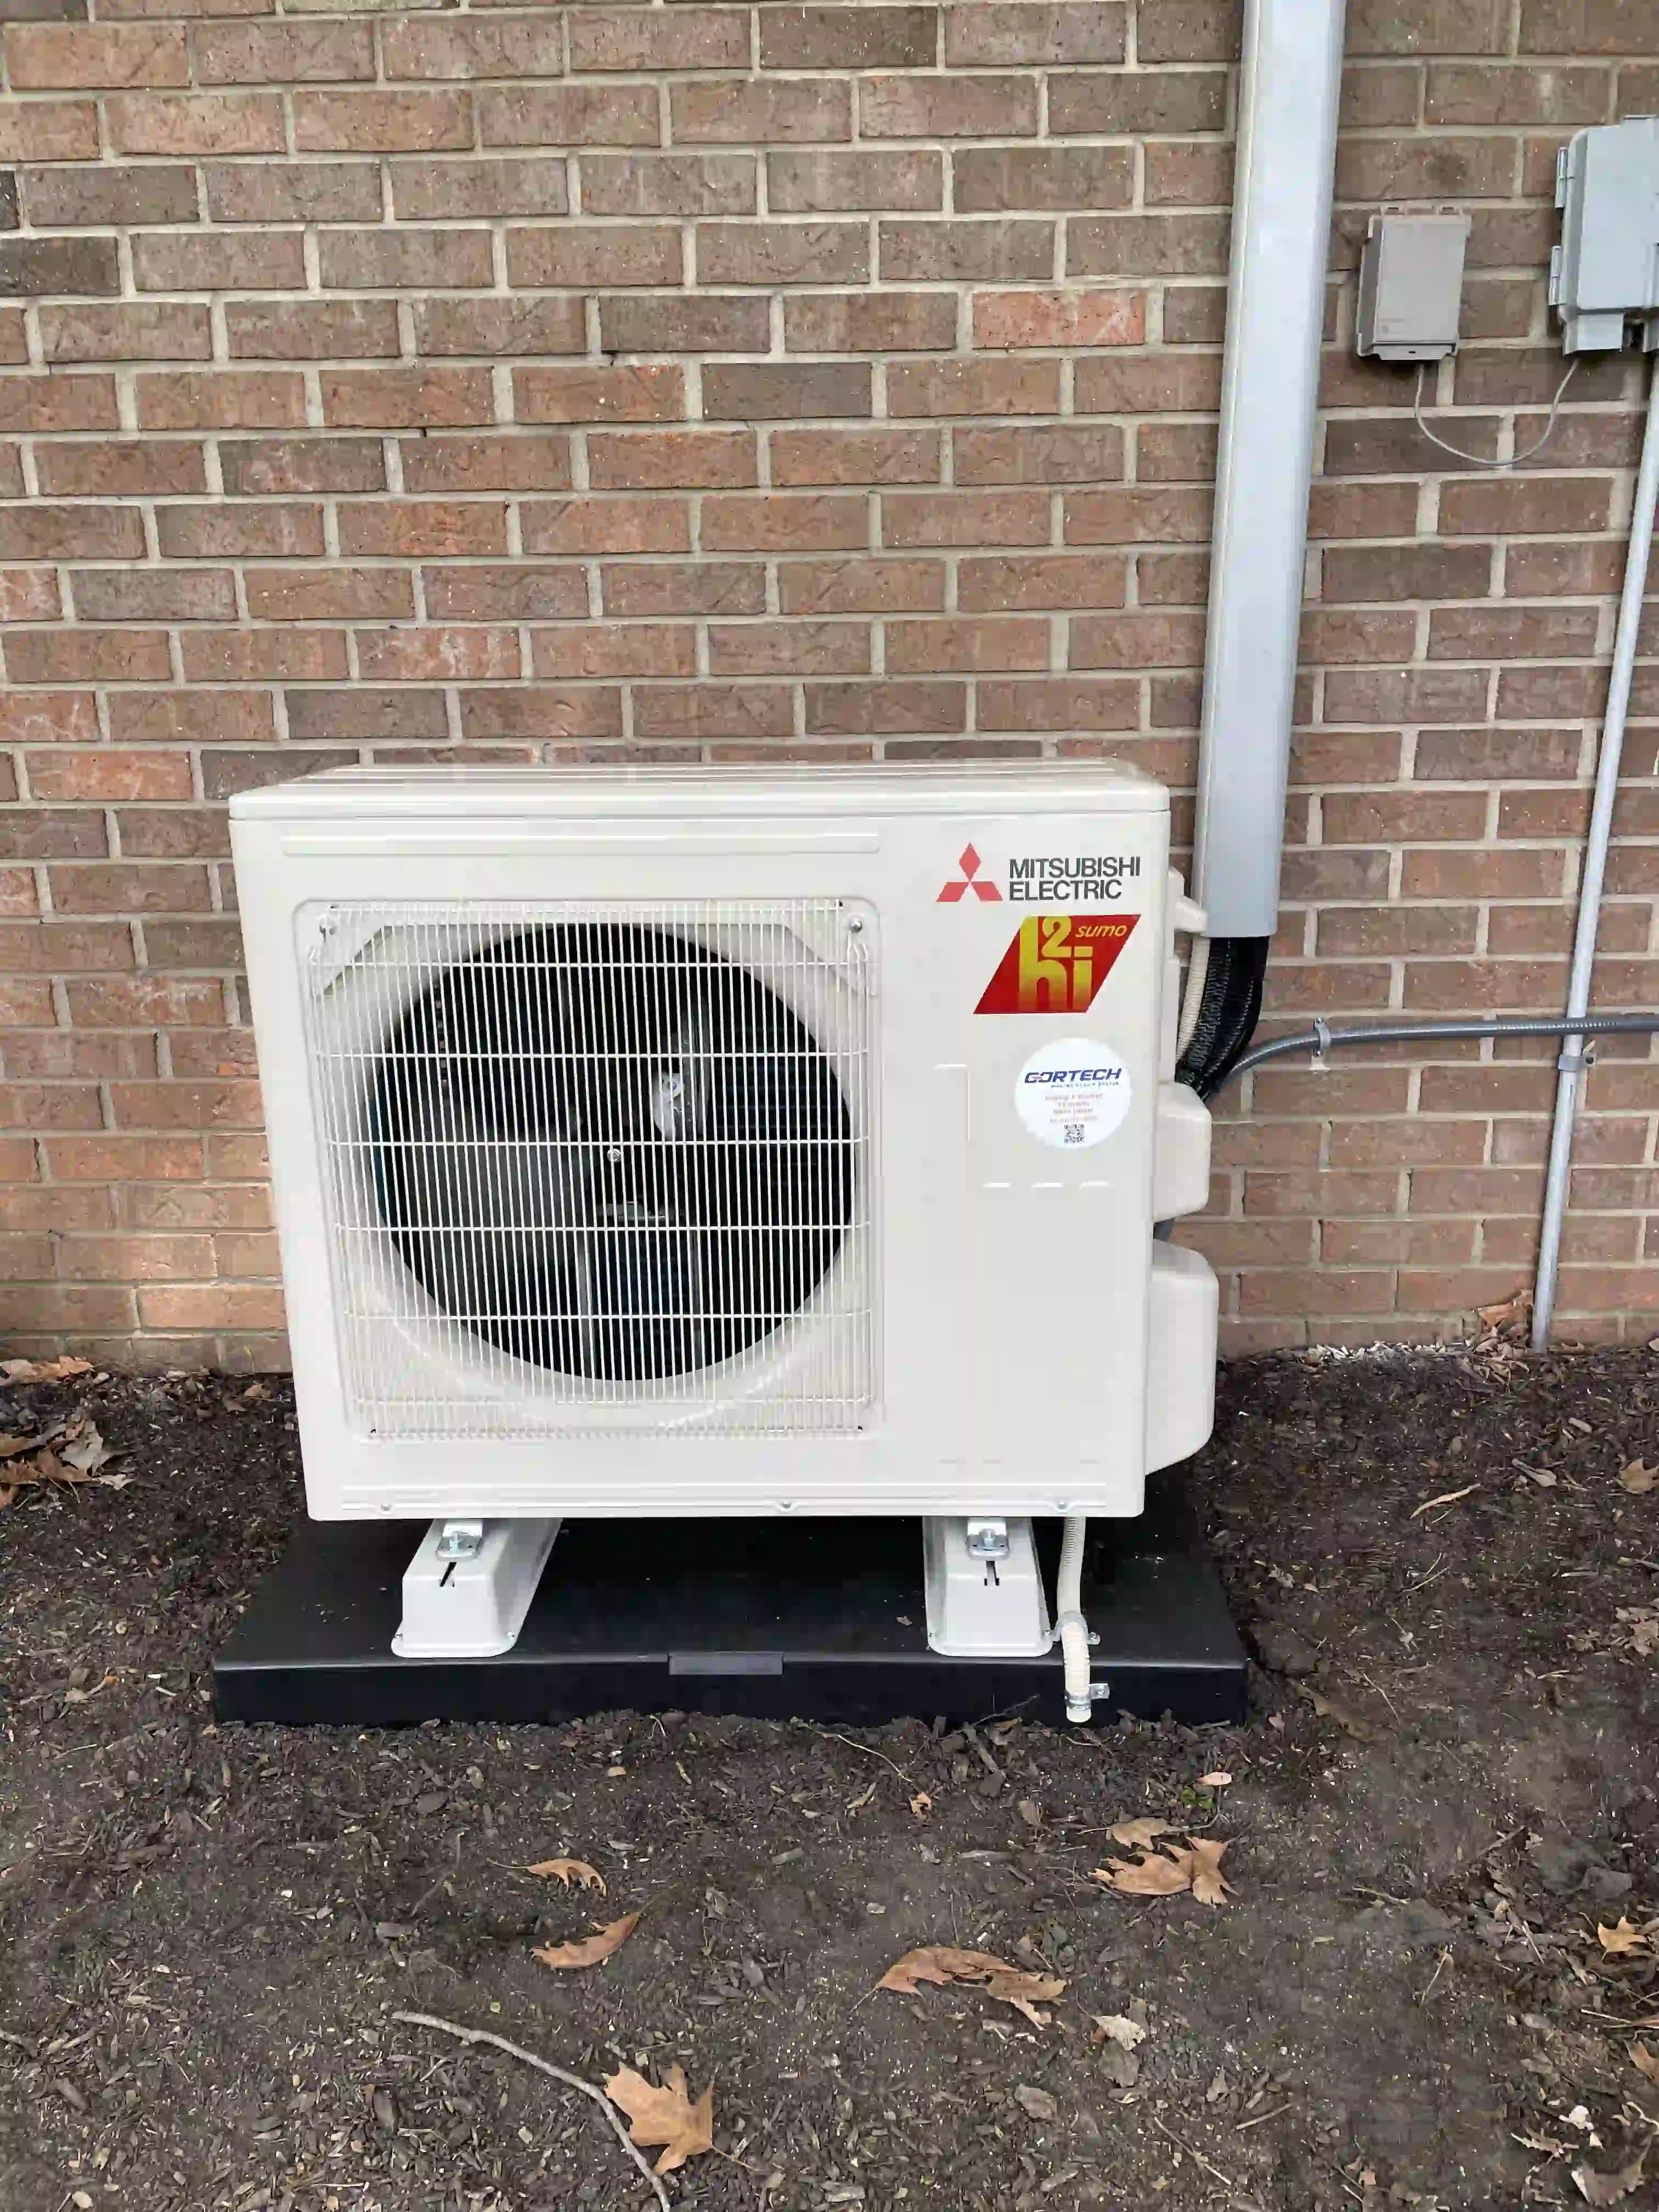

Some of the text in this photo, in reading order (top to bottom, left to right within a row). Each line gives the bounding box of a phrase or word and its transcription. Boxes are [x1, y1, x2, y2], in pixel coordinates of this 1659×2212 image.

[1009, 856, 1141, 879] MITSUBISHI
[1009, 879, 1122, 901] ELECTRIC
[1075, 924, 1127, 938] sumo
